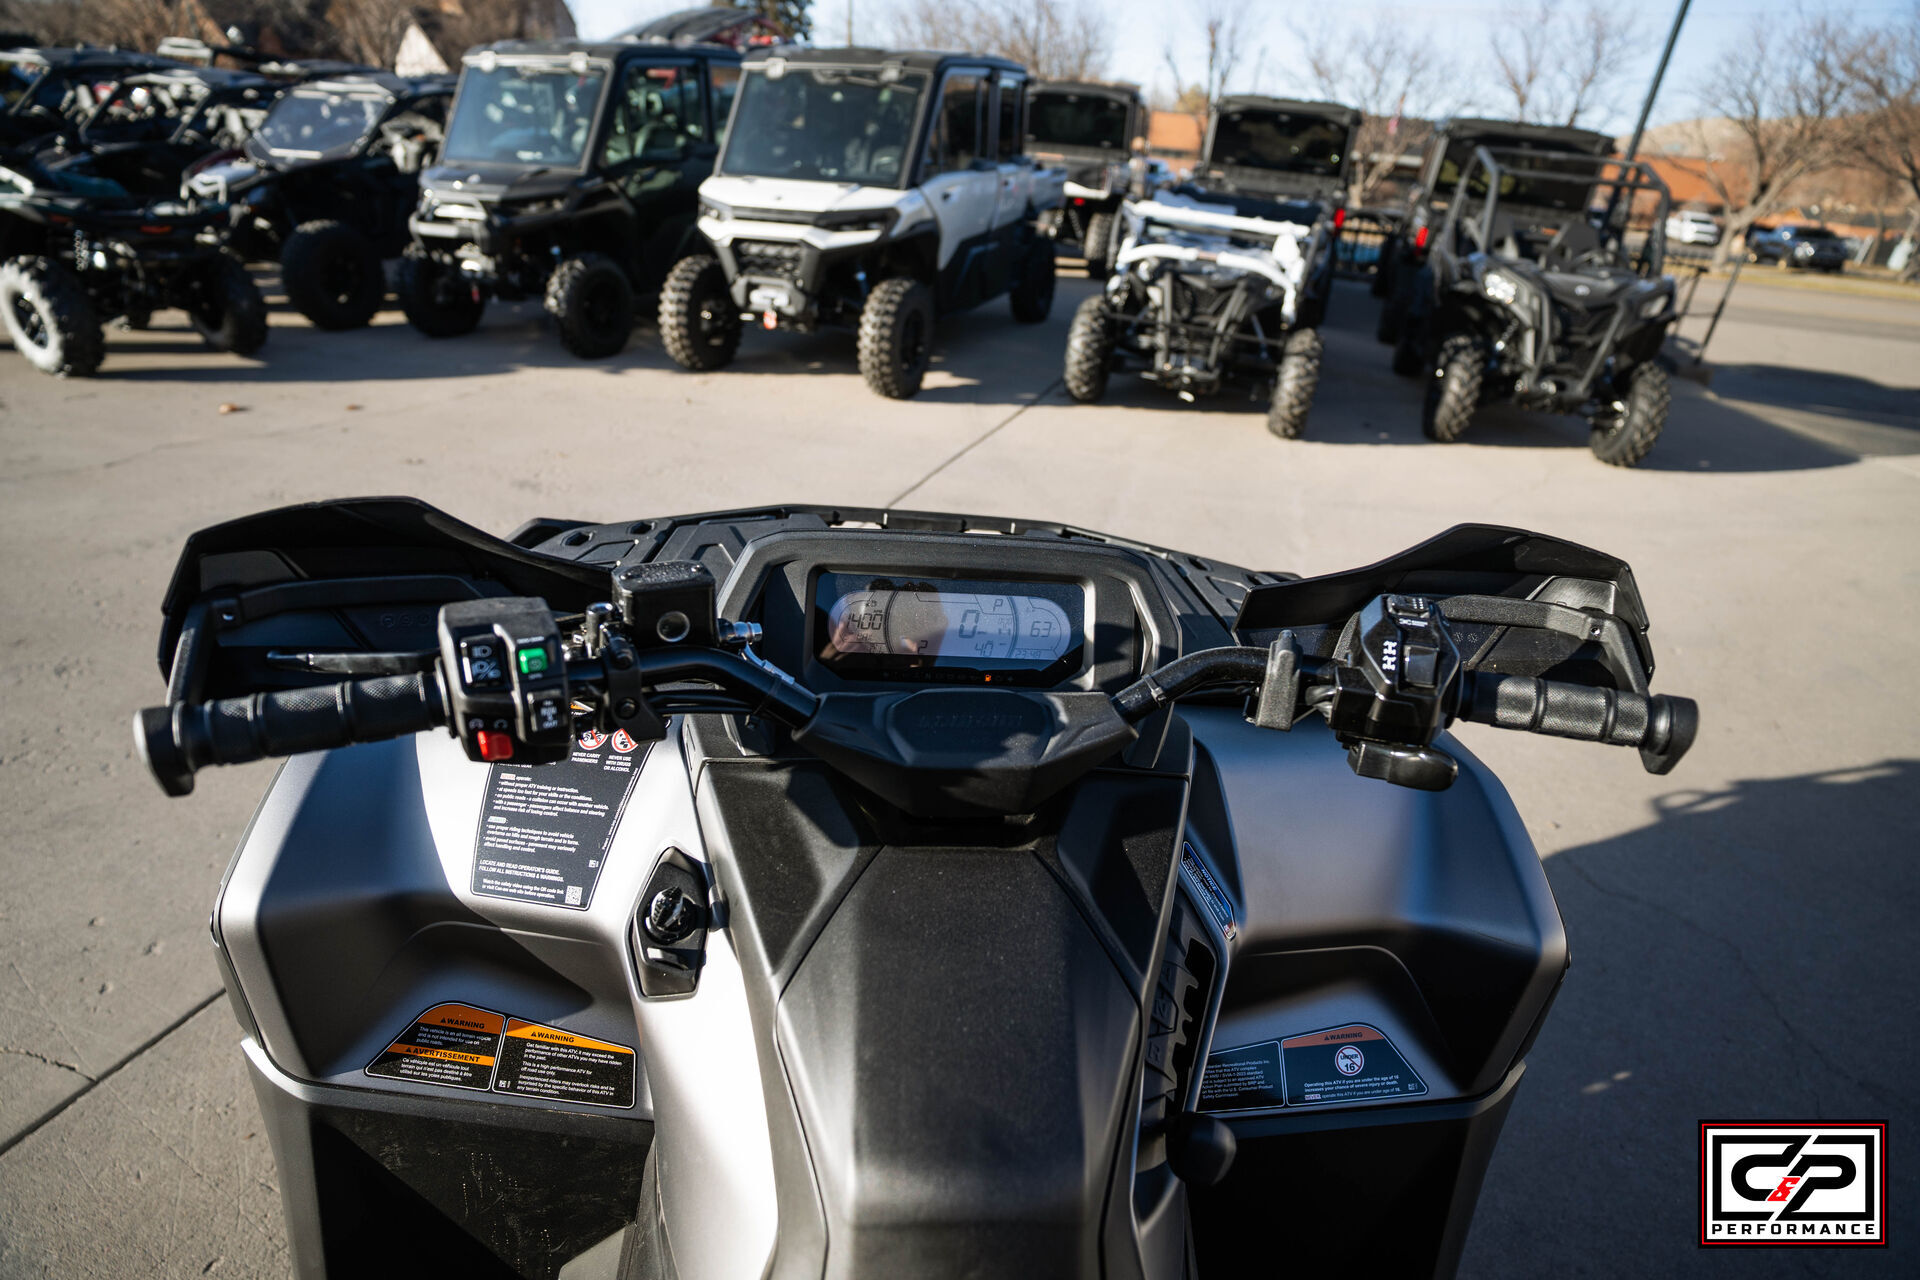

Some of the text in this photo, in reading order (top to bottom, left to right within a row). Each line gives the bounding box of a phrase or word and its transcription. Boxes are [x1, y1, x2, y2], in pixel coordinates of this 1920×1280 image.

[993, 598, 1004, 612] P
[845, 612, 883, 630] 1400
[959, 610, 980, 638] 0
[1030, 621, 1051, 637] 63
[505, 869, 536, 878] INSTRUCTIONS
[540, 874, 565, 882] WARNINGS.
[518, 865, 545, 873] OPERATOR'S
[1201, 869, 1217, 891] NOTICE
[447, 1018, 485, 1029] WARNING
[537, 1032, 574, 1042] WARNING
[1329, 1032, 1363, 1041] WARNING
[413, 1048, 480, 1062] AVERTISSEMENT
[525, 1048, 550, 1057] performance
[1345, 1063, 1355, 1071] 16
